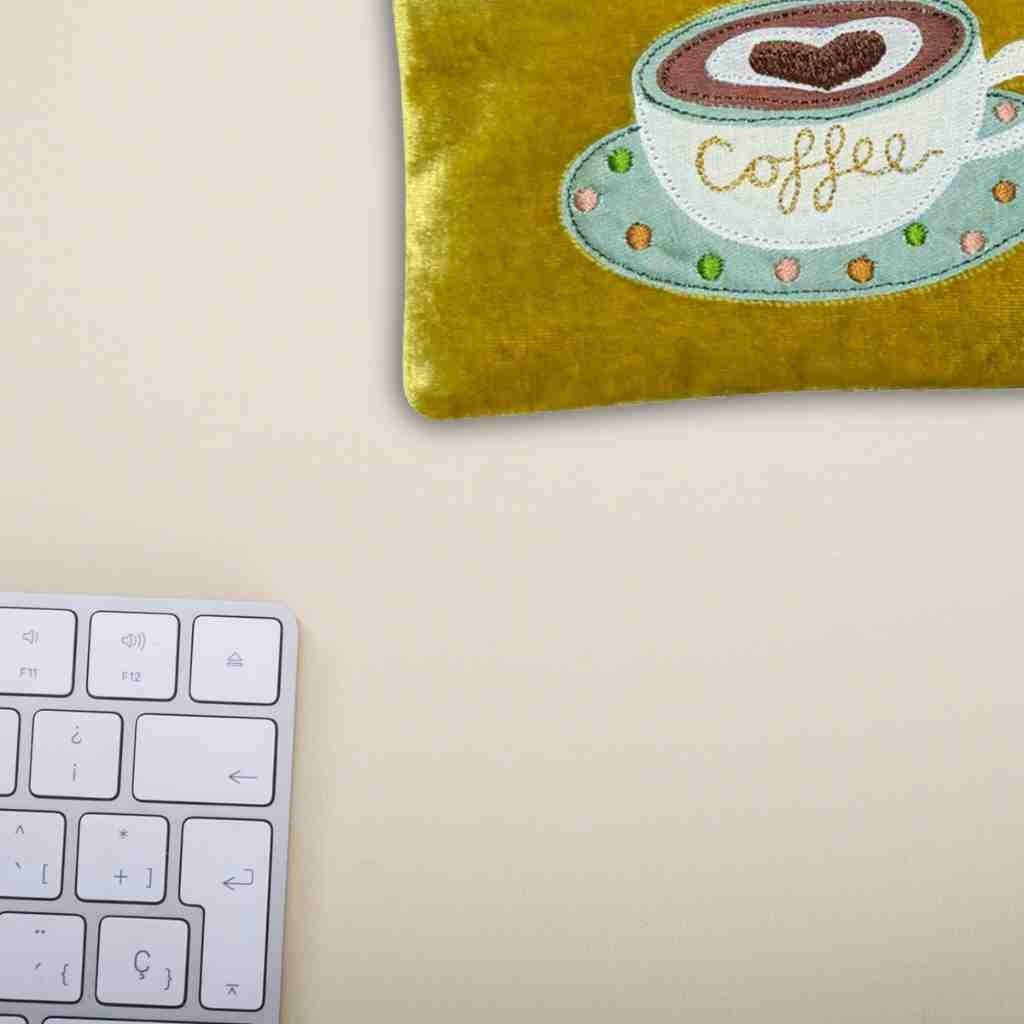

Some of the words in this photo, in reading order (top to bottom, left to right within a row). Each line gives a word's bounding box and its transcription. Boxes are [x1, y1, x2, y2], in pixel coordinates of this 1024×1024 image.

[695, 124, 945, 215] Coffee
[18, 666, 38, 679] F11
[121, 670, 142, 683] F12
[134, 950, 151, 980] Ç
